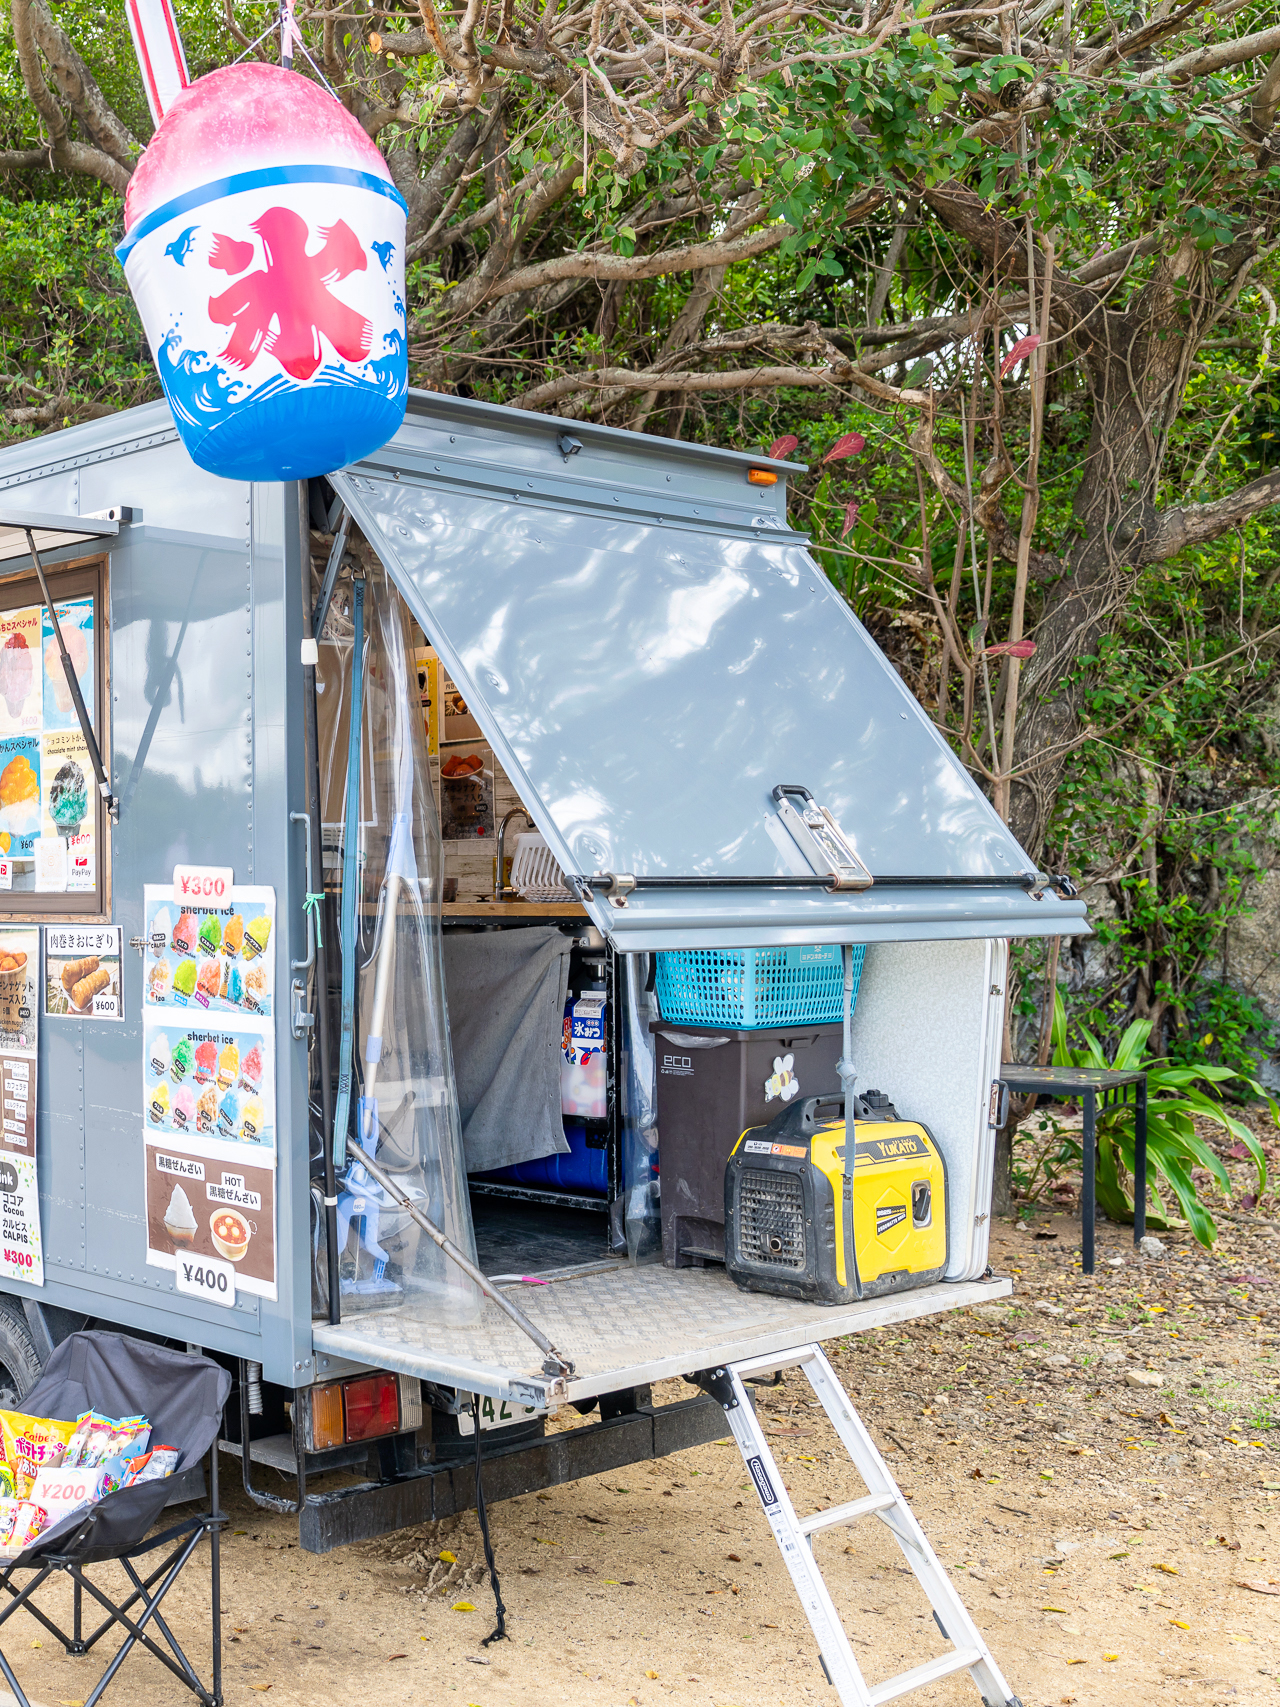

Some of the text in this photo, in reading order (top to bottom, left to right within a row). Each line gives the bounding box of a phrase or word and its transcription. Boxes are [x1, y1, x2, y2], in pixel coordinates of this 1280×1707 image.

[208, 207, 372, 381] 氷
[21, 715, 38, 726] ¥600
[47, 747, 66, 755] chocolate
[71, 834, 91, 846] ¥600
[71, 868, 91, 880] PayPay
[180, 875, 225, 897] ¥300
[50, 933, 113, 949] 肉巻きおにぎり
[95, 1000, 115, 1011] ¥600
[155, 994, 165, 1002] tea
[245, 997, 265, 1016] coffee
[573, 1021, 601, 1038] 氷みつ
[187, 1030, 234, 1045] sherbet ice
[663, 1054, 692, 1068] eco
[170, 1067, 183, 1082] melon
[6, 1082, 27, 1092] カフェラテ
[243, 1082, 259, 1096] grape
[6, 1101, 26, 1109] ミルクティー
[172, 1117, 190, 1133] peach
[201, 1122, 215, 1135] Cola
[243, 1130, 261, 1143] Lemon
[876, 1141, 918, 1157] YUKATO
[158, 1155, 203, 1175] 黒糖ぜんざい
[224, 1175, 242, 1188] HOT
[2, 1193, 24, 1207] ココア
[209, 1185, 259, 1205] 黒糖ぜんざい
[2, 1203, 25, 1218] Cocoa
[2, 1218, 28, 1233] カルピス
[2, 1229, 29, 1244] CALPIS
[3, 1248, 33, 1268] ¥300
[182, 1262, 228, 1293] ¥400
[23, 1430, 57, 1443] Calbee
[752, 1460, 772, 1501] Hasegawa
[40, 1483, 86, 1501] ¥200
